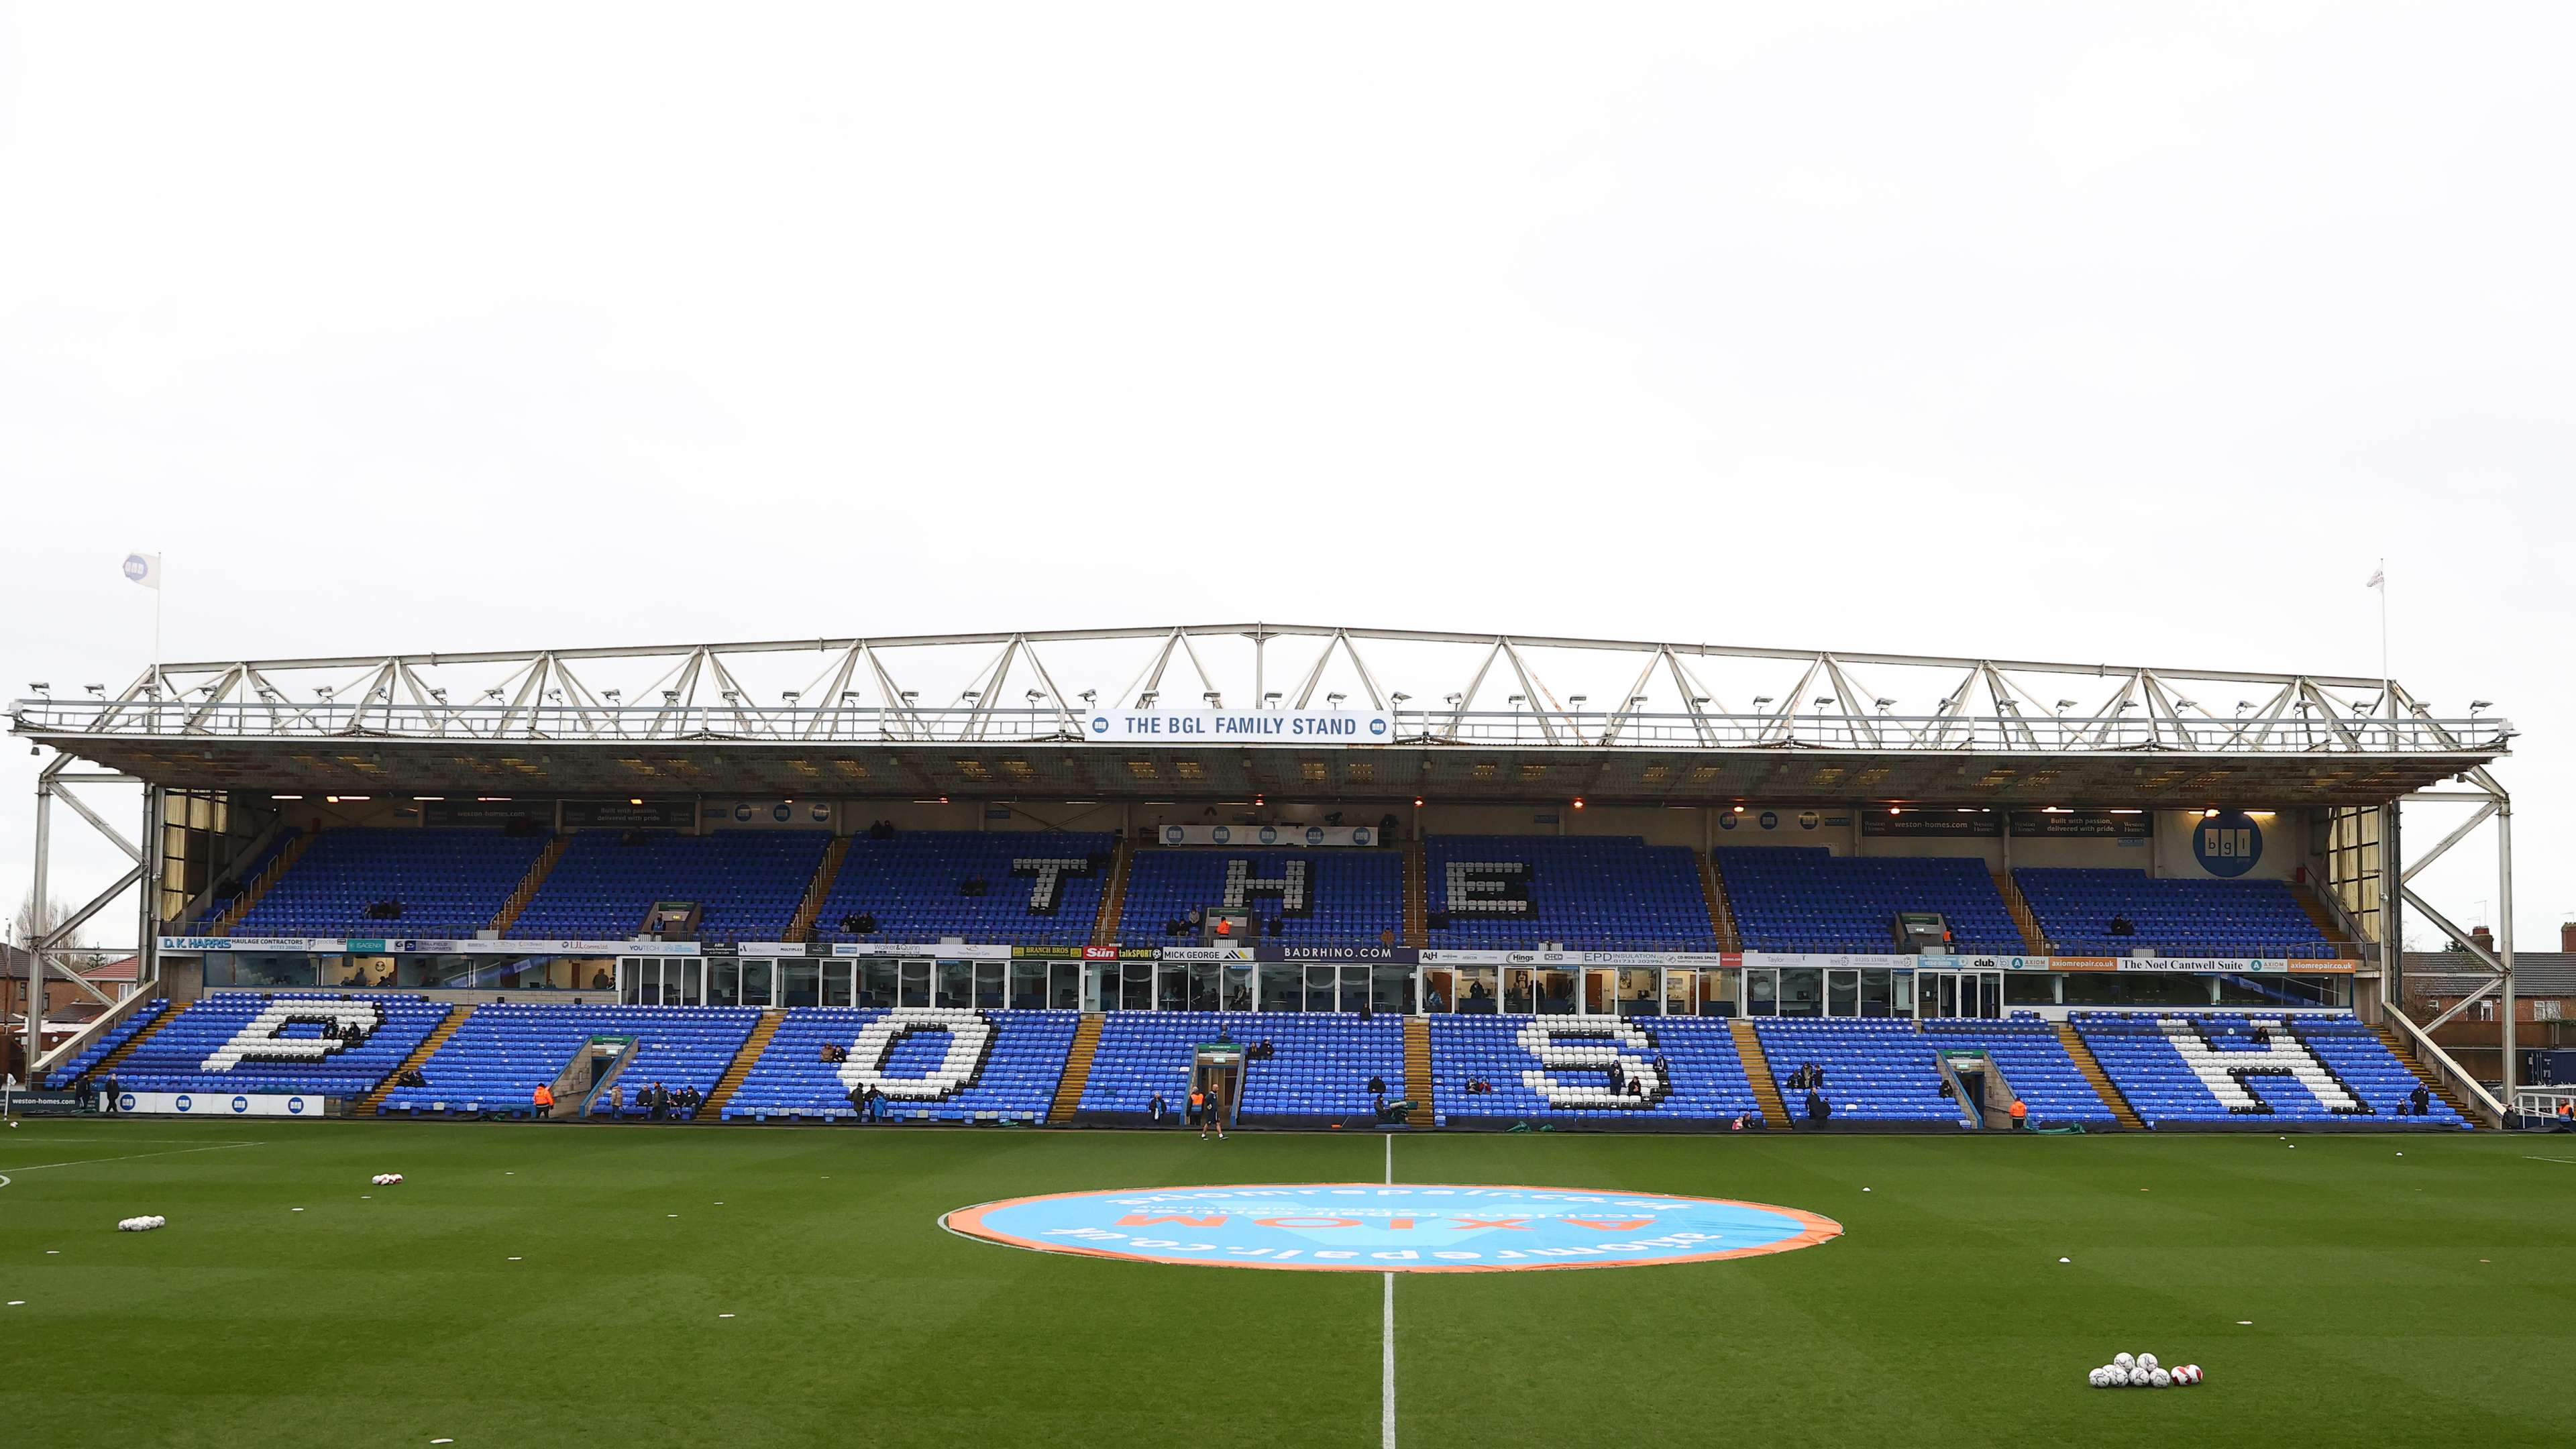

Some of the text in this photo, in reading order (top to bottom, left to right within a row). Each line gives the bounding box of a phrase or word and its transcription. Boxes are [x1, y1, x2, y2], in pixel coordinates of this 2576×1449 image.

[1125, 717, 1356, 735] THE BGL FAMILY STAND
[2208, 837, 2245, 855] bgl
[1013, 859, 1527, 911] T H E
[189, 939, 231, 949] HARRIS
[1086, 948, 1114, 957] Sun
[1118, 949, 1152, 958] talkSPORT
[1164, 951, 1220, 959] MICK GEORGE
[1284, 947, 1392, 958] BADRHINO.COM
[1584, 953, 1613, 961] EPD
[2051, 959, 2114, 969] axiomrepair.co.uk
[2122, 959, 2244, 970] The Noel Cantwell Suite
[2290, 961, 2352, 970] axiomrepair.co.uk
[200, 1000, 2357, 1108] P O S H
[12, 1097, 76, 1106] weston-homes.com
[1113, 1214, 1660, 1231] AXIOM
[1040, 1227, 1723, 1260] axiomrepair.co.uk
